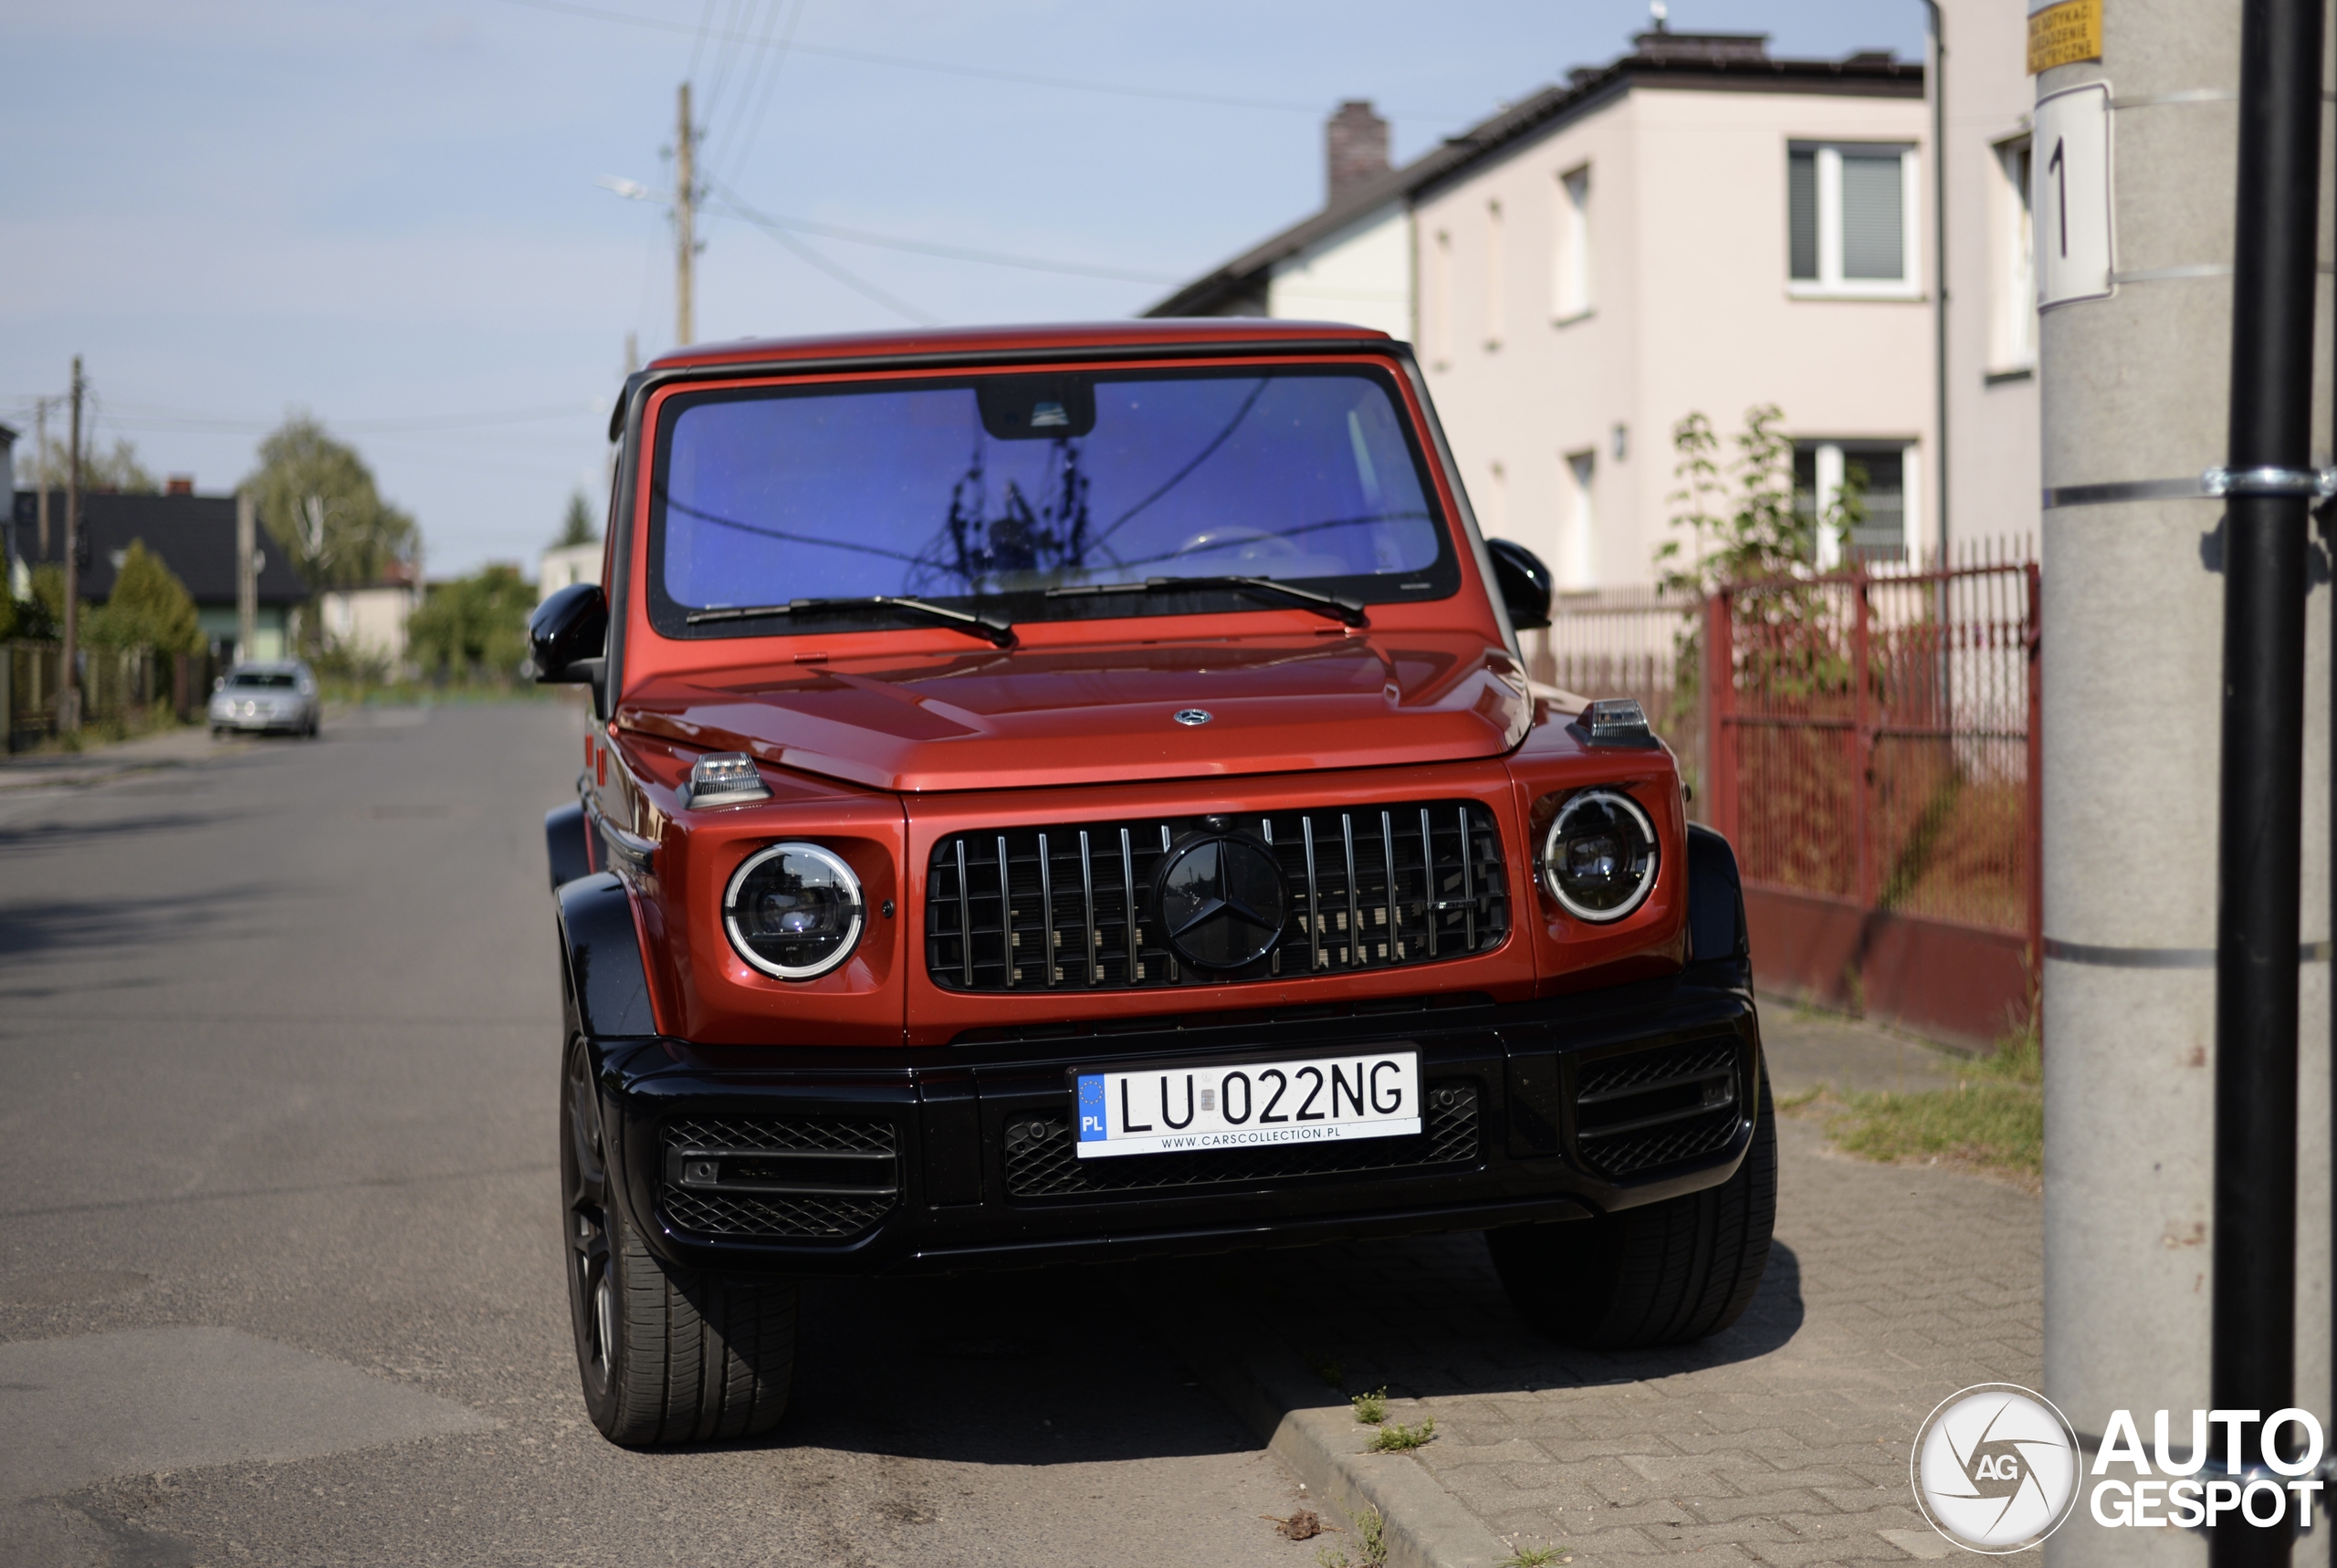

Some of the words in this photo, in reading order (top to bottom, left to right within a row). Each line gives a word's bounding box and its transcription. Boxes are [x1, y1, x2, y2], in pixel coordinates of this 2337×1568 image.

[2049, 135, 2067, 258] 1
[1120, 1074, 1194, 1134] LU
[1221, 1061, 1401, 1125] 022NG
[1082, 1115, 1103, 1132] PL
[1161, 1127, 1341, 1148] WWW.CARSCOLLECTION.PL
